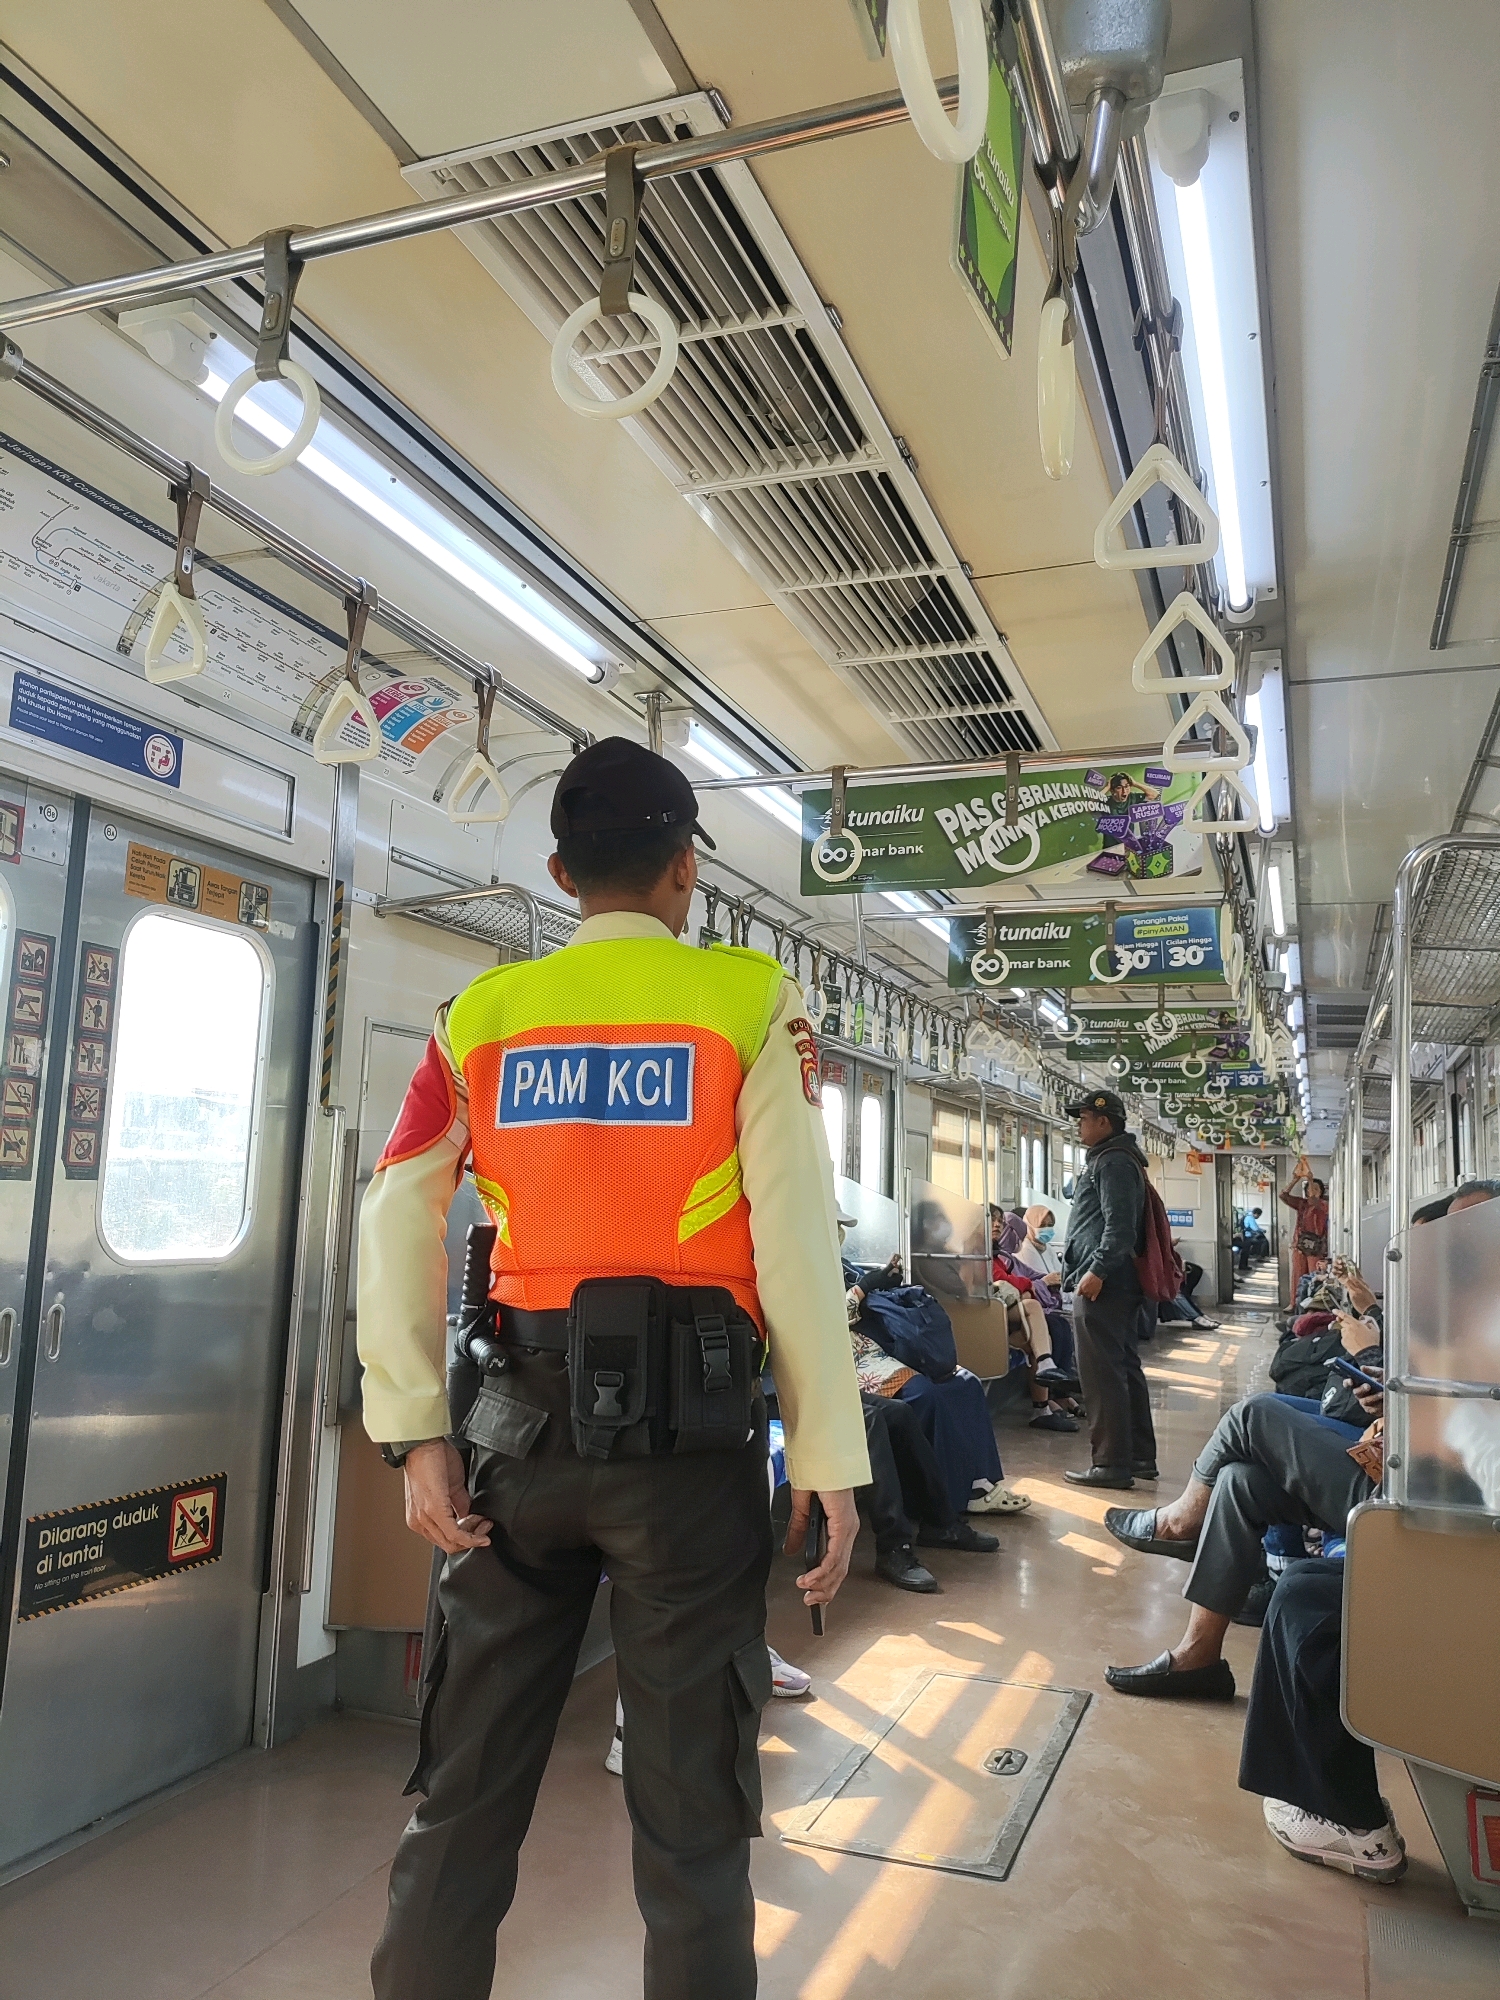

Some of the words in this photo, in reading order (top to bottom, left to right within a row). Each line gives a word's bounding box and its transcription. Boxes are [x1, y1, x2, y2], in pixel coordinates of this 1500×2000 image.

[987, 139, 1014, 208] tunaiku
[985, 185, 999, 215] amar
[7, 443, 53, 470] Jaringan
[52, 469, 74, 483] KRL
[74, 482, 124, 512] Commuter
[124, 511, 143, 524] Line
[93, 574, 121, 592] Jakarta
[223, 691, 231, 699] 24
[18, 687, 36, 698] duduk
[36, 695, 59, 708] kepada
[92, 717, 105, 727] yang
[19, 678, 39, 691] Mohon
[76, 703, 91, 713] untuk
[123, 721, 142, 732] tempat
[847, 804, 925, 827] tunaiku
[1049, 800, 1111, 821] KEROYOKAN
[1132, 804, 1160, 814] LAPTOP
[1135, 810, 1160, 819] RUSAK
[934, 797, 994, 845] PAS
[1096, 824, 1124, 833] MOGOK
[1100, 818, 1125, 826] MOTOR
[131, 857, 147, 866] Celah
[153, 855, 166, 864] Pada
[129, 871, 146, 881] Kereta
[207, 881, 220, 890] Awas
[220, 884, 238, 896] Tangan
[1132, 917, 1167, 925] Tenangin
[1168, 914, 1189, 923] Pakai
[999, 922, 1072, 941] tunaiku
[1135, 941, 1159, 949] Hingga
[1188, 937, 1213, 945] Hingga
[1115, 949, 1151, 970] 30
[1168, 945, 1205, 967] 30
[1090, 1018, 1129, 1028] tunaiku
[513, 1057, 588, 1108] PAM
[607, 1057, 674, 1108] KCI
[1239, 1074, 1259, 1086] 30
[38, 1518, 108, 1549] Dilarang
[112, 1503, 160, 1529] duduk
[36, 1556, 52, 1574] di
[57, 1541, 104, 1570] lantai
[34, 1582, 44, 1591] No
[44, 1577, 61, 1589] sitting
[80, 1568, 93, 1578] train
[93, 1564, 107, 1574] floor
